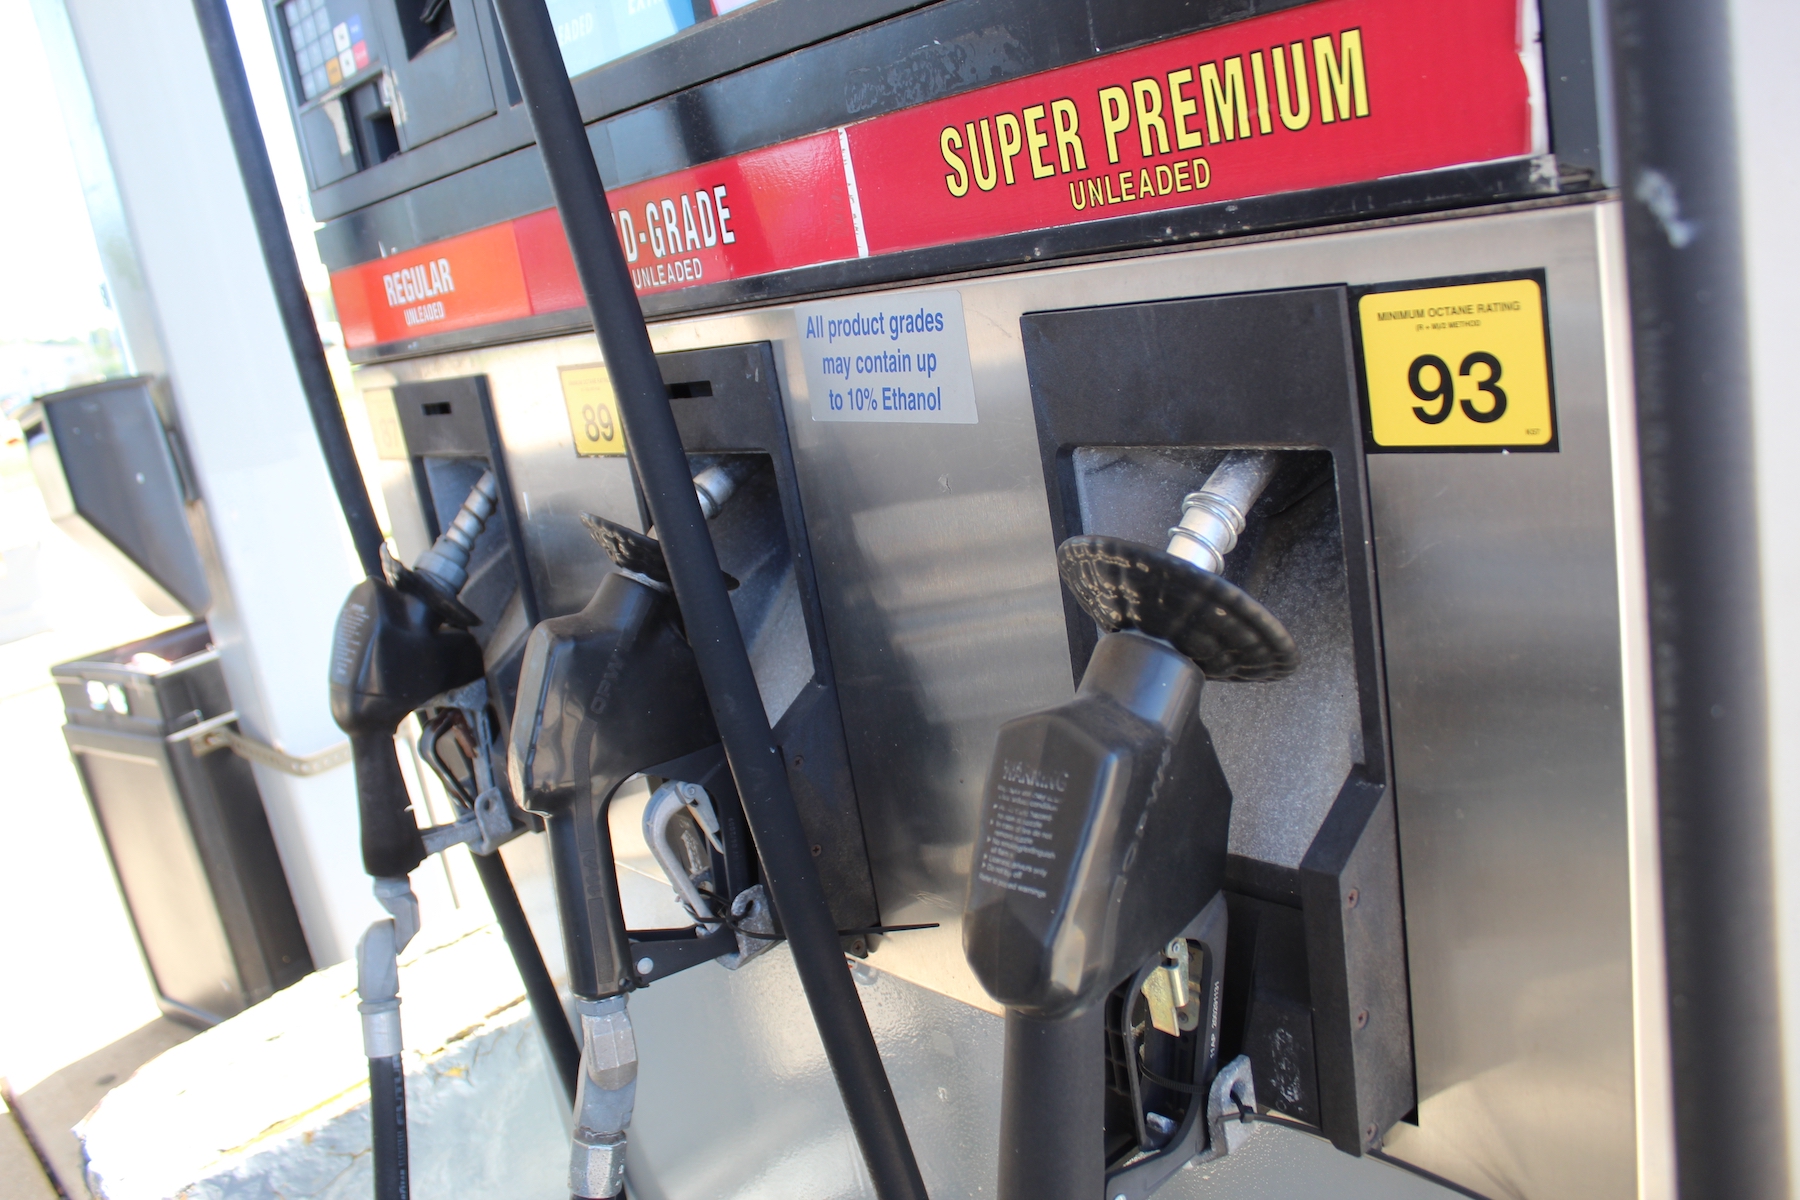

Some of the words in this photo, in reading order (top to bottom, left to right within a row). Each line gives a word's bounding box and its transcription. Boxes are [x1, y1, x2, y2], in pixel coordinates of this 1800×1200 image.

[940, 97, 1088, 198] SUPER
[1097, 26, 1371, 165] PREMIUM
[1069, 157, 1211, 211] UNLEADED
[611, 184, 735, 262] D-GRADE
[383, 258, 455, 308] REGULAR
[632, 257, 703, 290] UNLEADED
[403, 301, 445, 327] UNLEADED
[806, 315, 824, 339] All
[828, 312, 885, 344] product
[889, 308, 944, 341] grades
[1377, 309, 1425, 322] MINIMUM
[1428, 305, 1474, 318] OCTANE
[1477, 301, 1521, 314] RATING
[822, 356, 851, 380] may
[856, 348, 912, 374] contain
[917, 352, 937, 378] up
[829, 389, 843, 410] to
[848, 387, 878, 411] 10%
[882, 386, 942, 411] Ethanol
[1407, 351, 1508, 425] 93
[582, 403, 614, 442] 89
